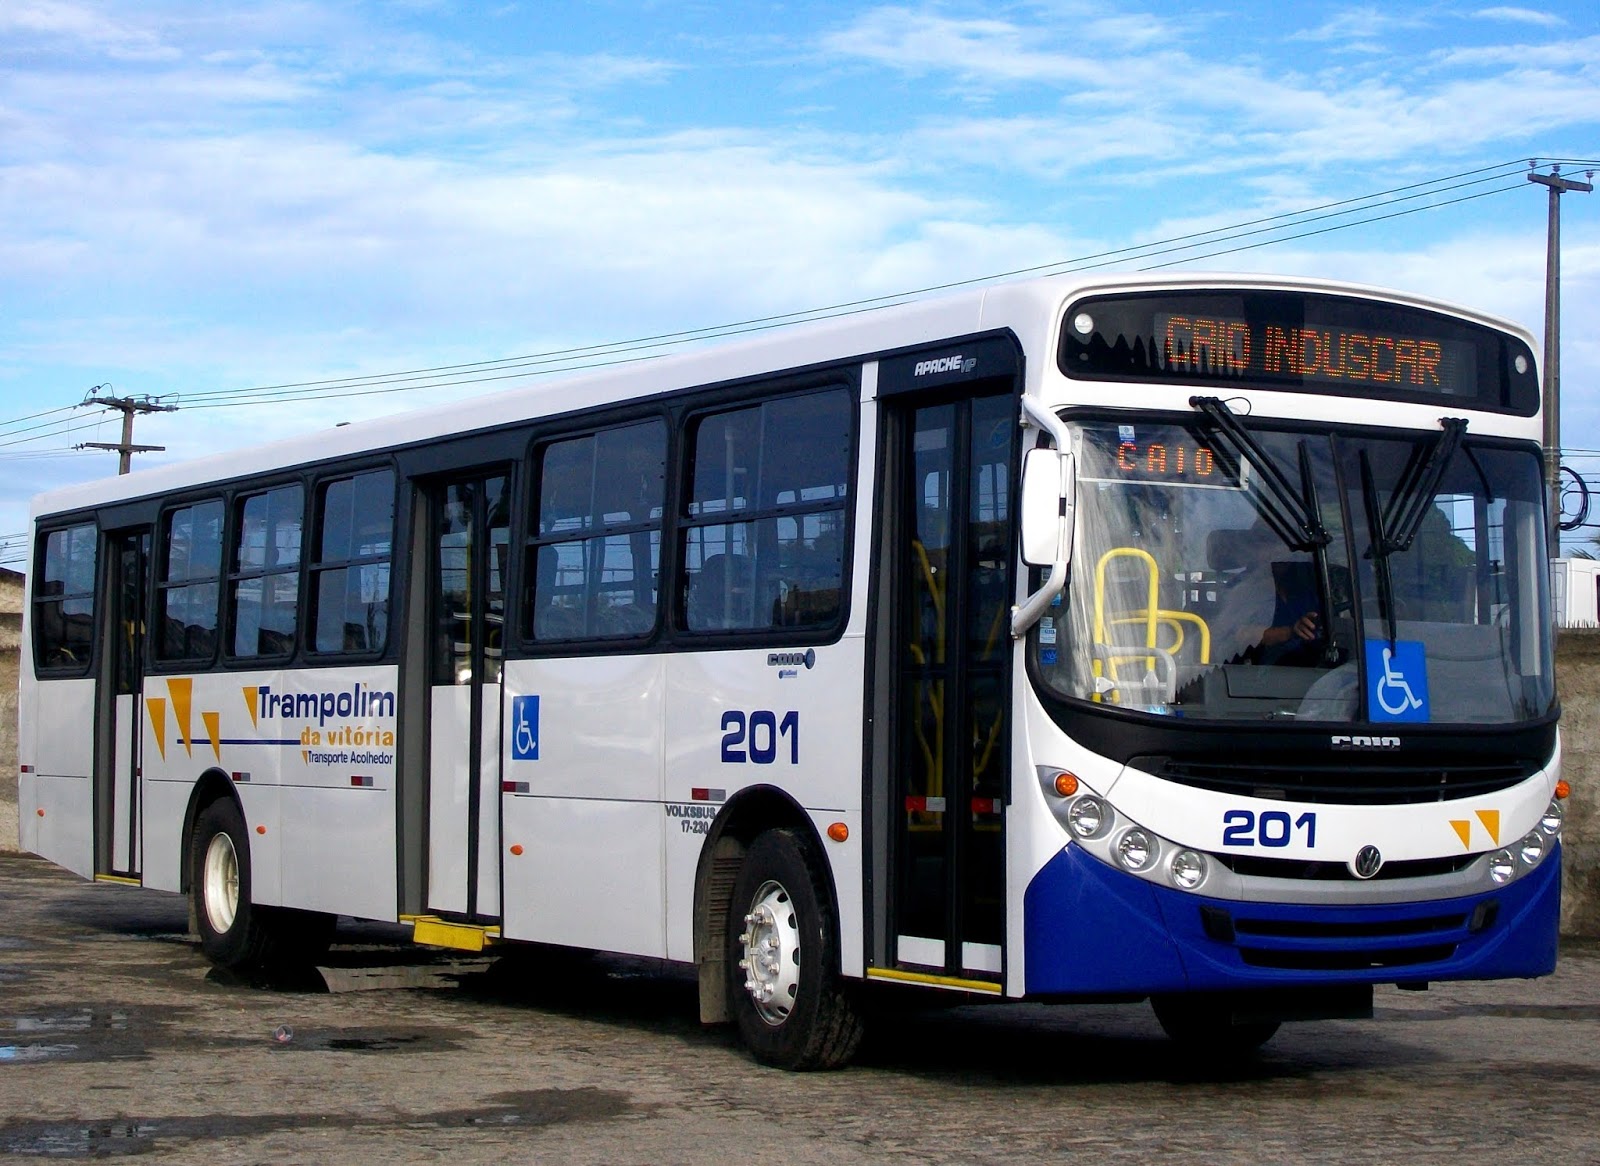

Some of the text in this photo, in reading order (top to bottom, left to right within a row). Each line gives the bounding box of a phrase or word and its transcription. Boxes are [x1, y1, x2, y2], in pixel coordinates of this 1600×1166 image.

[1166, 316, 1442, 386] CAIO INDUSCAR
[914, 355, 962, 376] APACHE
[1118, 443, 1213, 475] CAIO
[767, 652, 804, 666] CAIO
[258, 682, 395, 727] Trampolim
[301, 725, 394, 747] da vitória
[720, 710, 799, 765] 201
[308, 750, 394, 766] Transporte Acolhedor
[665, 804, 716, 820] VOLKSBUS
[1222, 809, 1317, 848] 201
